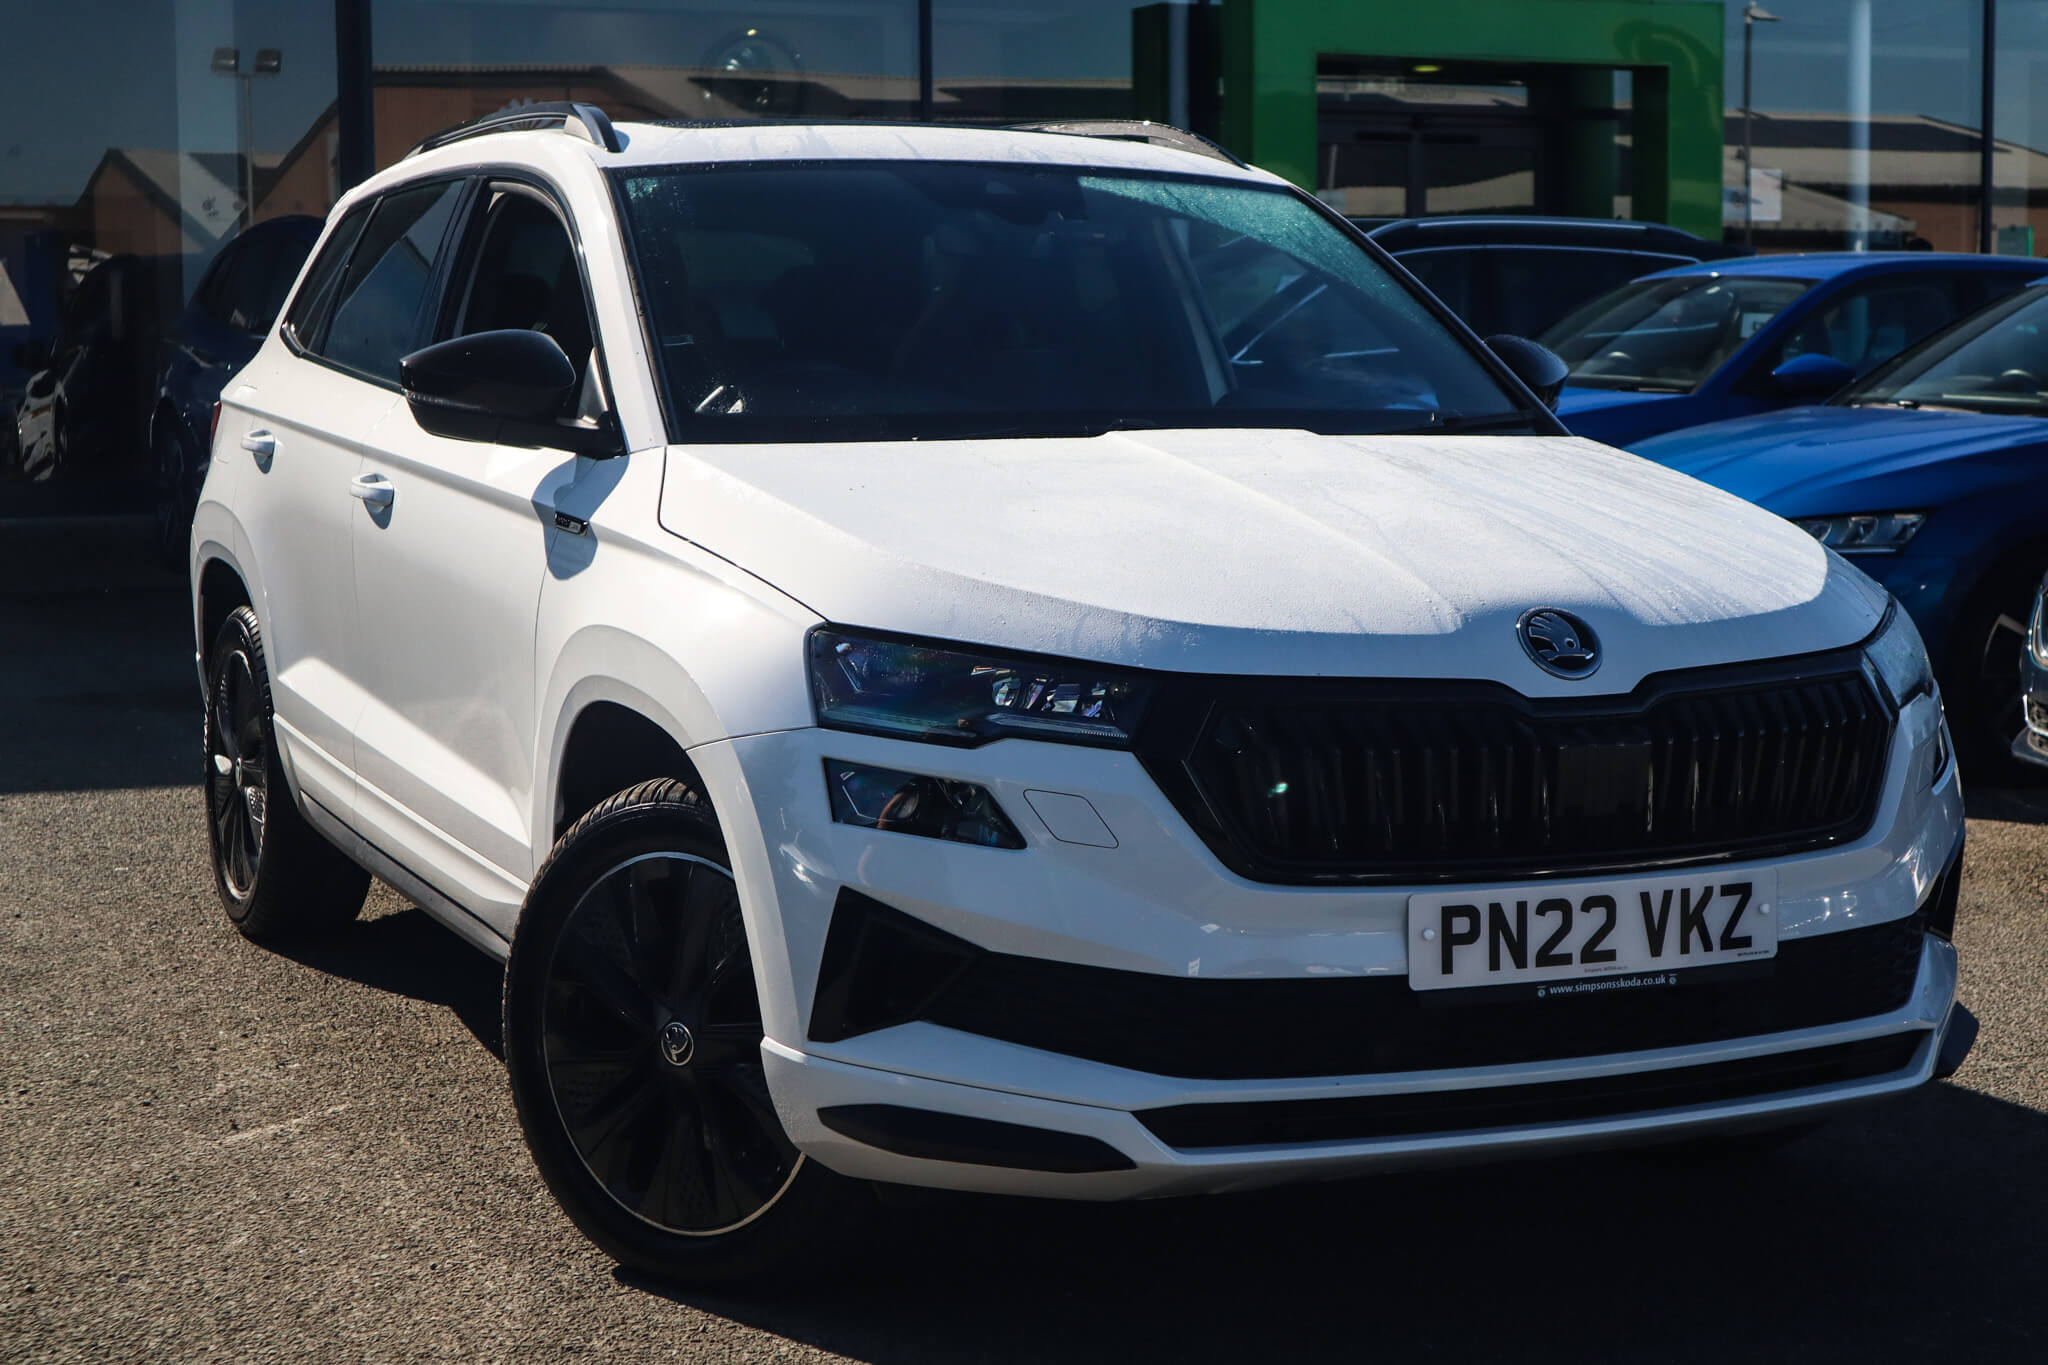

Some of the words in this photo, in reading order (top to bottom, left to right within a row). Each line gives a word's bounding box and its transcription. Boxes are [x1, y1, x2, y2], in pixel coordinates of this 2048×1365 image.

[1441, 895, 1617, 975] PN22
[1639, 882, 1753, 958] VKZ
[1549, 974, 1666, 995] www.simpsonsskoda.co.uk
